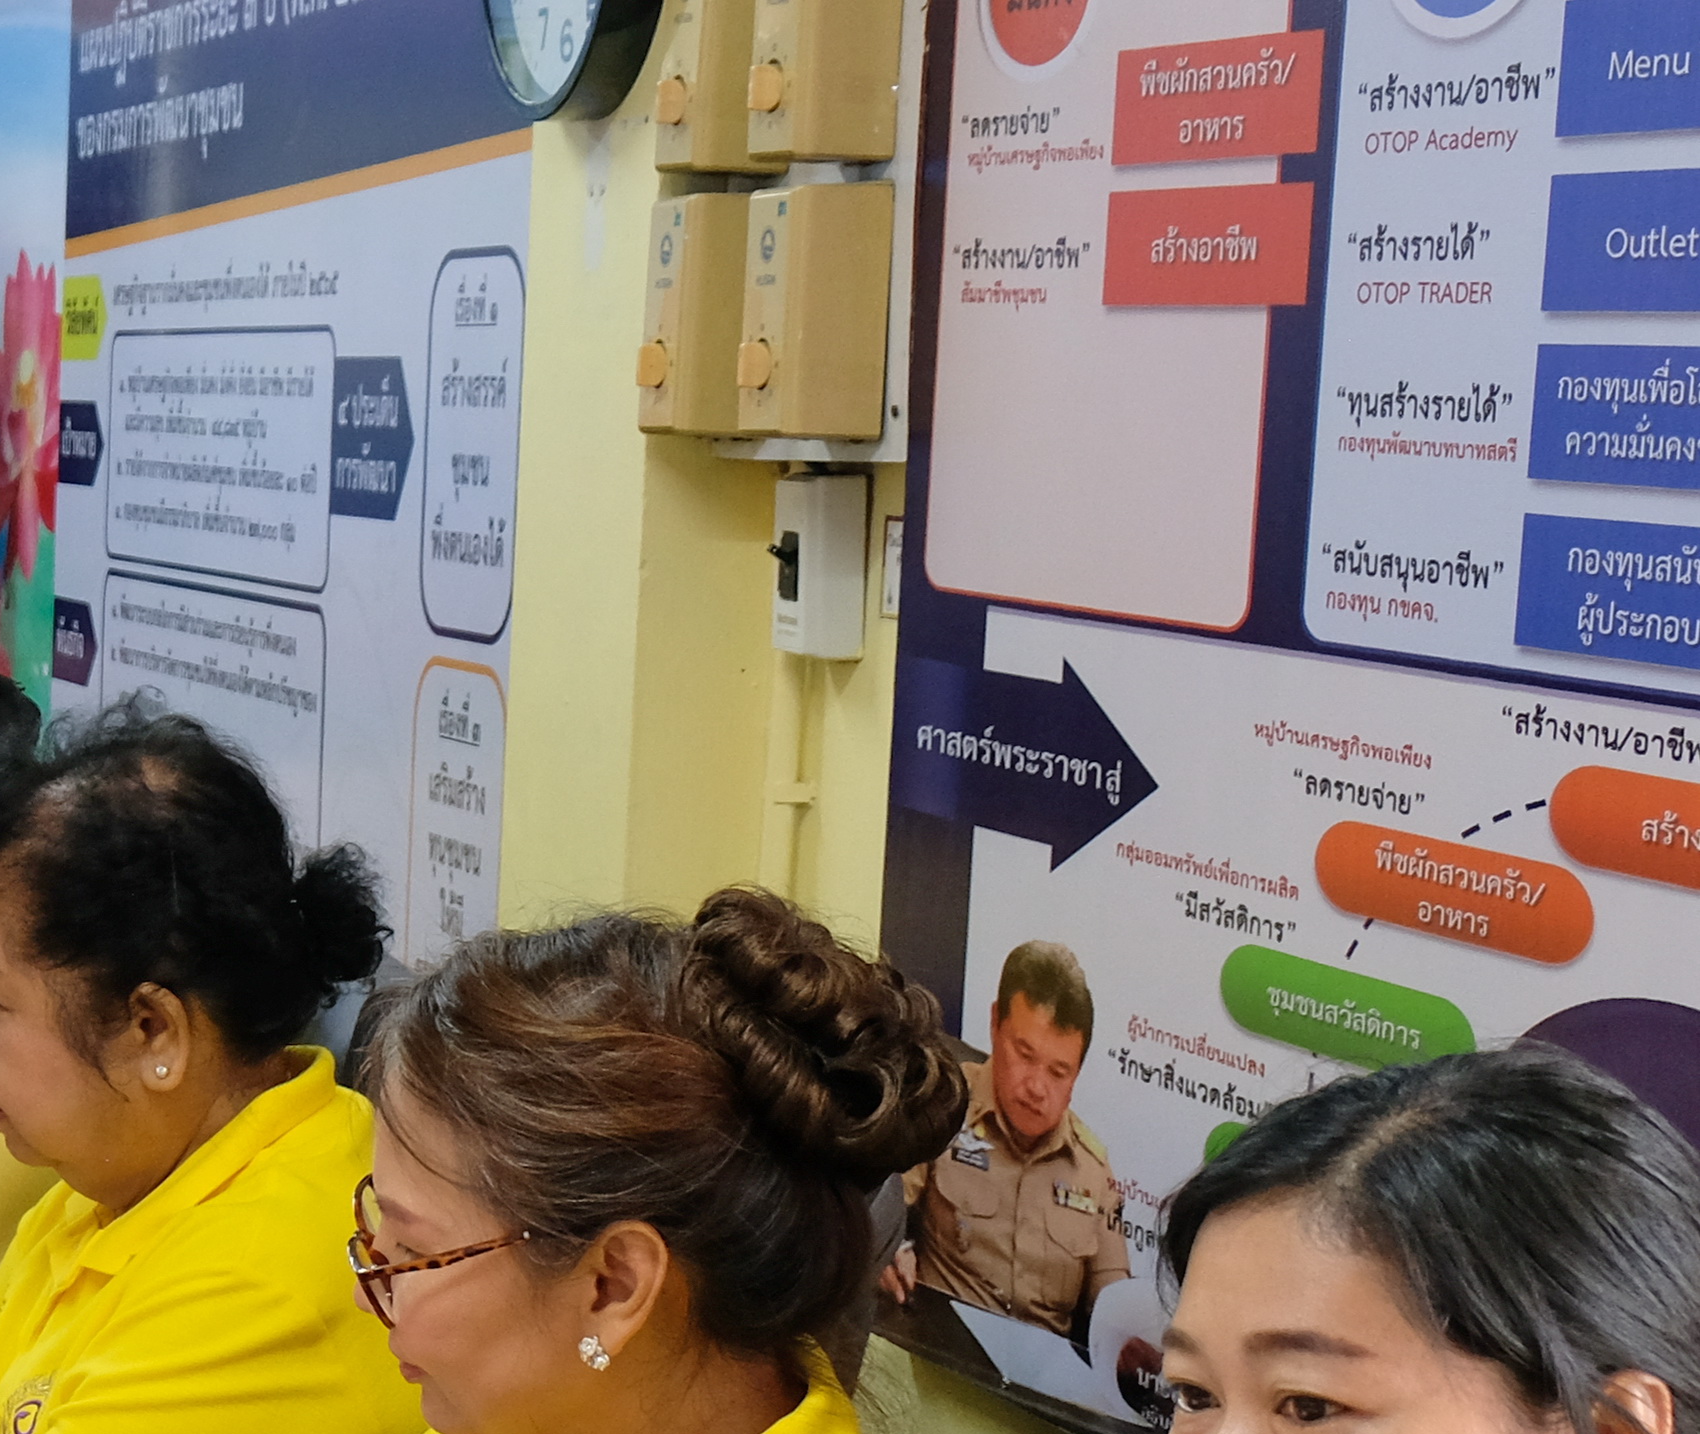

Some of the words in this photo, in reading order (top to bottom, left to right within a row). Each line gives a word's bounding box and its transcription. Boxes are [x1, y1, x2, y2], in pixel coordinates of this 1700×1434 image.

[538, 7, 549, 51] 7
[560, 18, 574, 62] 6
[1138, 47, 1296, 98] พืชผักสวนครัว/
[1358, 62, 1557, 113] “สร้างงาน/อาชีพ”
[1607, 49, 1692, 82] Menu
[1178, 114, 1245, 145] อาหาร
[1364, 129, 1419, 156] OTOP
[1425, 126, 1519, 153] Academy
[967, 138, 1105, 174] หมู่บ้านเศรษฐกิจพอเพียง
[1150, 223, 1258, 265] สร้างอาชีพ
[1347, 222, 1491, 263] “สร้างรายได้”
[1605, 226, 1700, 260] Outlet
[961, 279, 1048, 312] สัมมาชีพชุมชน
[1357, 282, 1410, 305] OTOP
[1417, 281, 1493, 305] TRADER
[351, 374, 400, 429] ประเด็น
[441, 357, 508, 408] สร้างสรรค์
[1337, 380, 1513, 427] “ทุนสร้างรายได้”
[1558, 357, 1700, 415] กองทุนเพื่อโ
[1338, 430, 1518, 463] กองทุนพัฒนาบทบาทสตรี
[1565, 413, 1700, 462] ความมั่นคง
[335, 441, 397, 493] การพัฒนา
[451, 452, 490, 502] ชุมชน
[431, 502, 507, 567] พึ่งตนเองได้
[1322, 540, 1504, 592] “สนับสนุนอาชีพ”
[1325, 590, 1382, 624] กองทุน
[1387, 596, 1438, 624] กขคจ.
[1253, 719, 1432, 771] หมู่บ้านเศรษฐกิจพอเพียง
[428, 761, 486, 816] เสริมสร้าง
[1293, 768, 1426, 816] “ลดรายจ่าย”
[1115, 841, 1300, 902] กลุ่มออมทรัพย์เพื่อการผลิต
[1374, 839, 1546, 908] พืชผักสวนครัว/
[1175, 890, 1297, 943] “มีสวัสดิการ”
[1417, 899, 1489, 939] อาหาร
[1266, 985, 1423, 1051] ชุมชนสวัสดิการ
[1127, 1014, 1267, 1079] ผู้นำการเปลี่ยนแปลง
